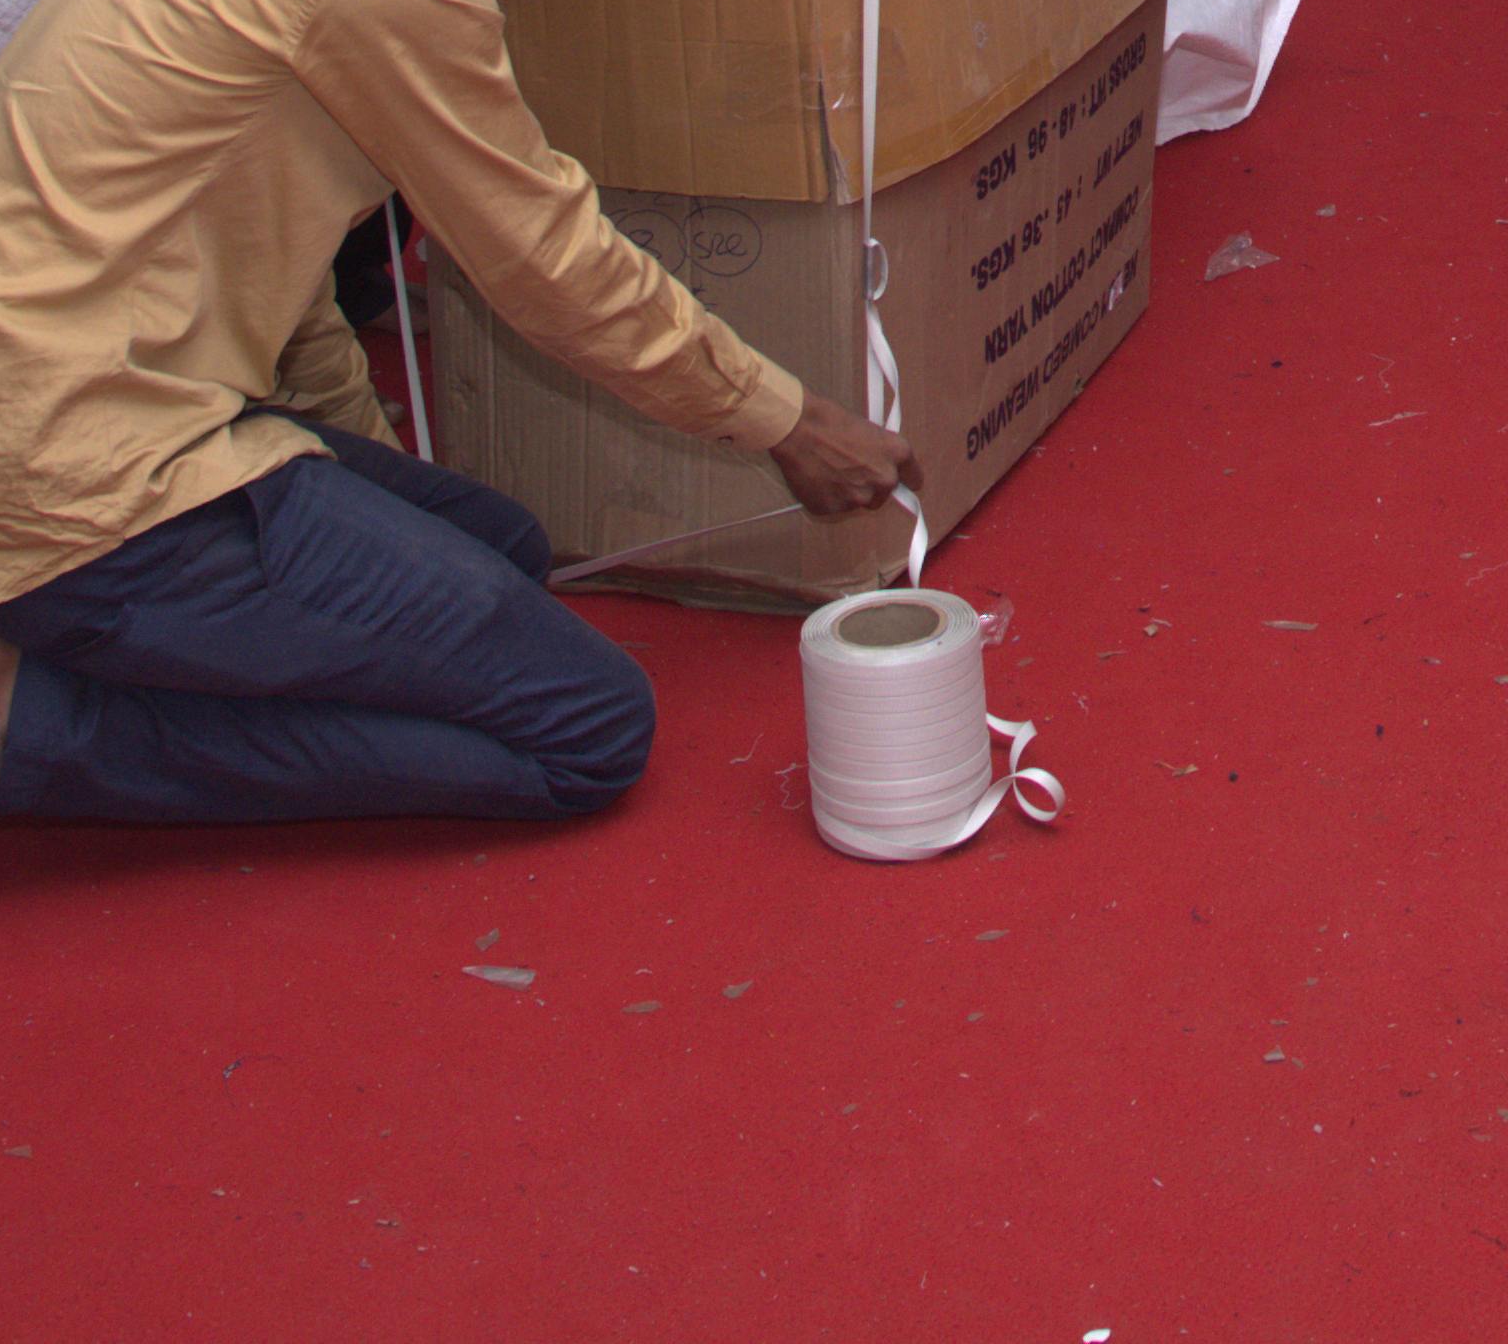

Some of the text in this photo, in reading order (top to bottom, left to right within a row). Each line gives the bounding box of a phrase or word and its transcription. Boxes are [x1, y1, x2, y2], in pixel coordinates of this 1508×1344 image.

[1108, 31, 1147, 96] GROSS
[1030, 246, 1087, 325] COTTON
[984, 299, 1030, 365] YARN
[965, 363, 1041, 462] WEAVING
